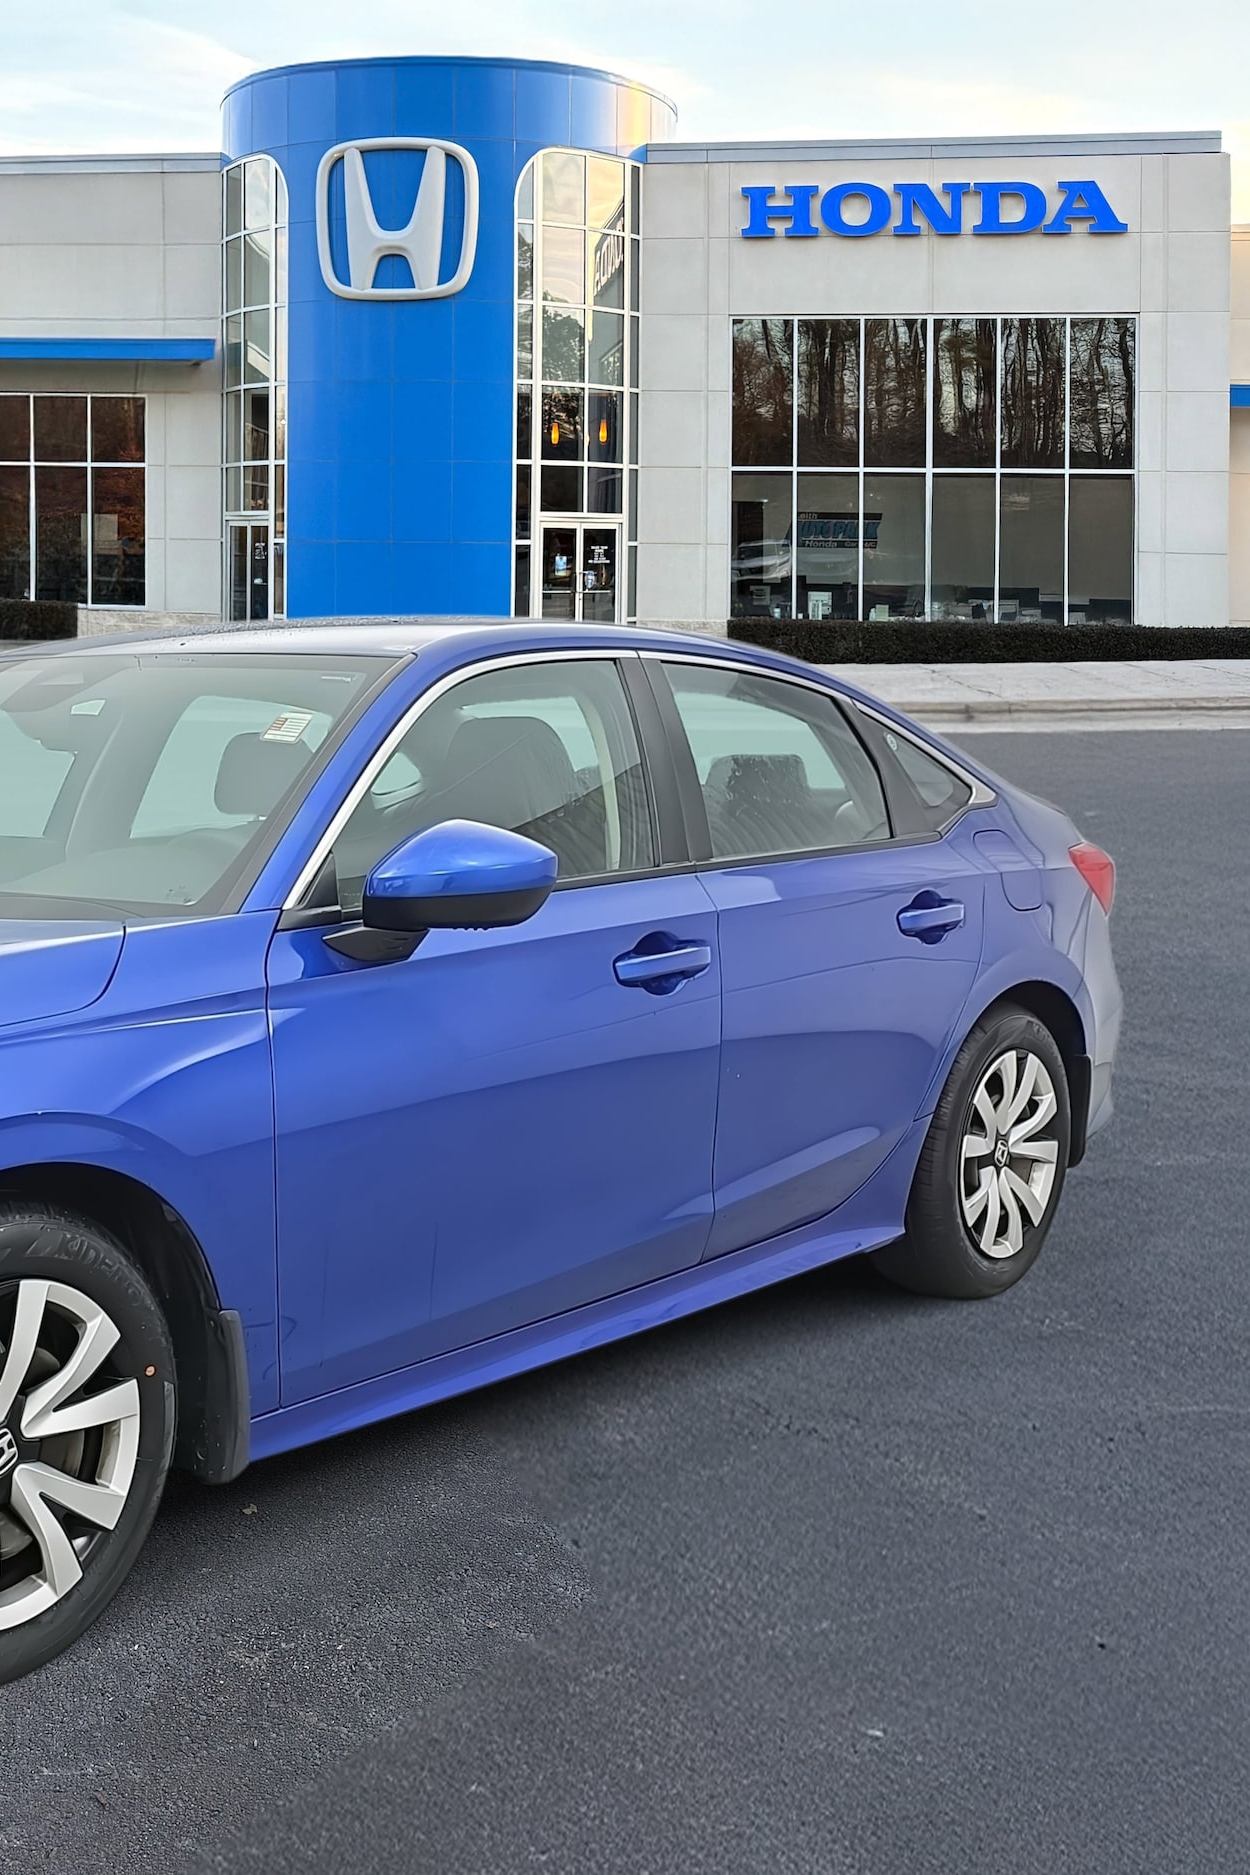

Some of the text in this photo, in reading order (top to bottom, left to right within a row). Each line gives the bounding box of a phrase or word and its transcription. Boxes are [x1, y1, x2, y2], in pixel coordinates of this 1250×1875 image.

[741, 180, 1129, 238] HONDA
[797, 512, 818, 520] eith
[805, 540, 837, 548] Honda
